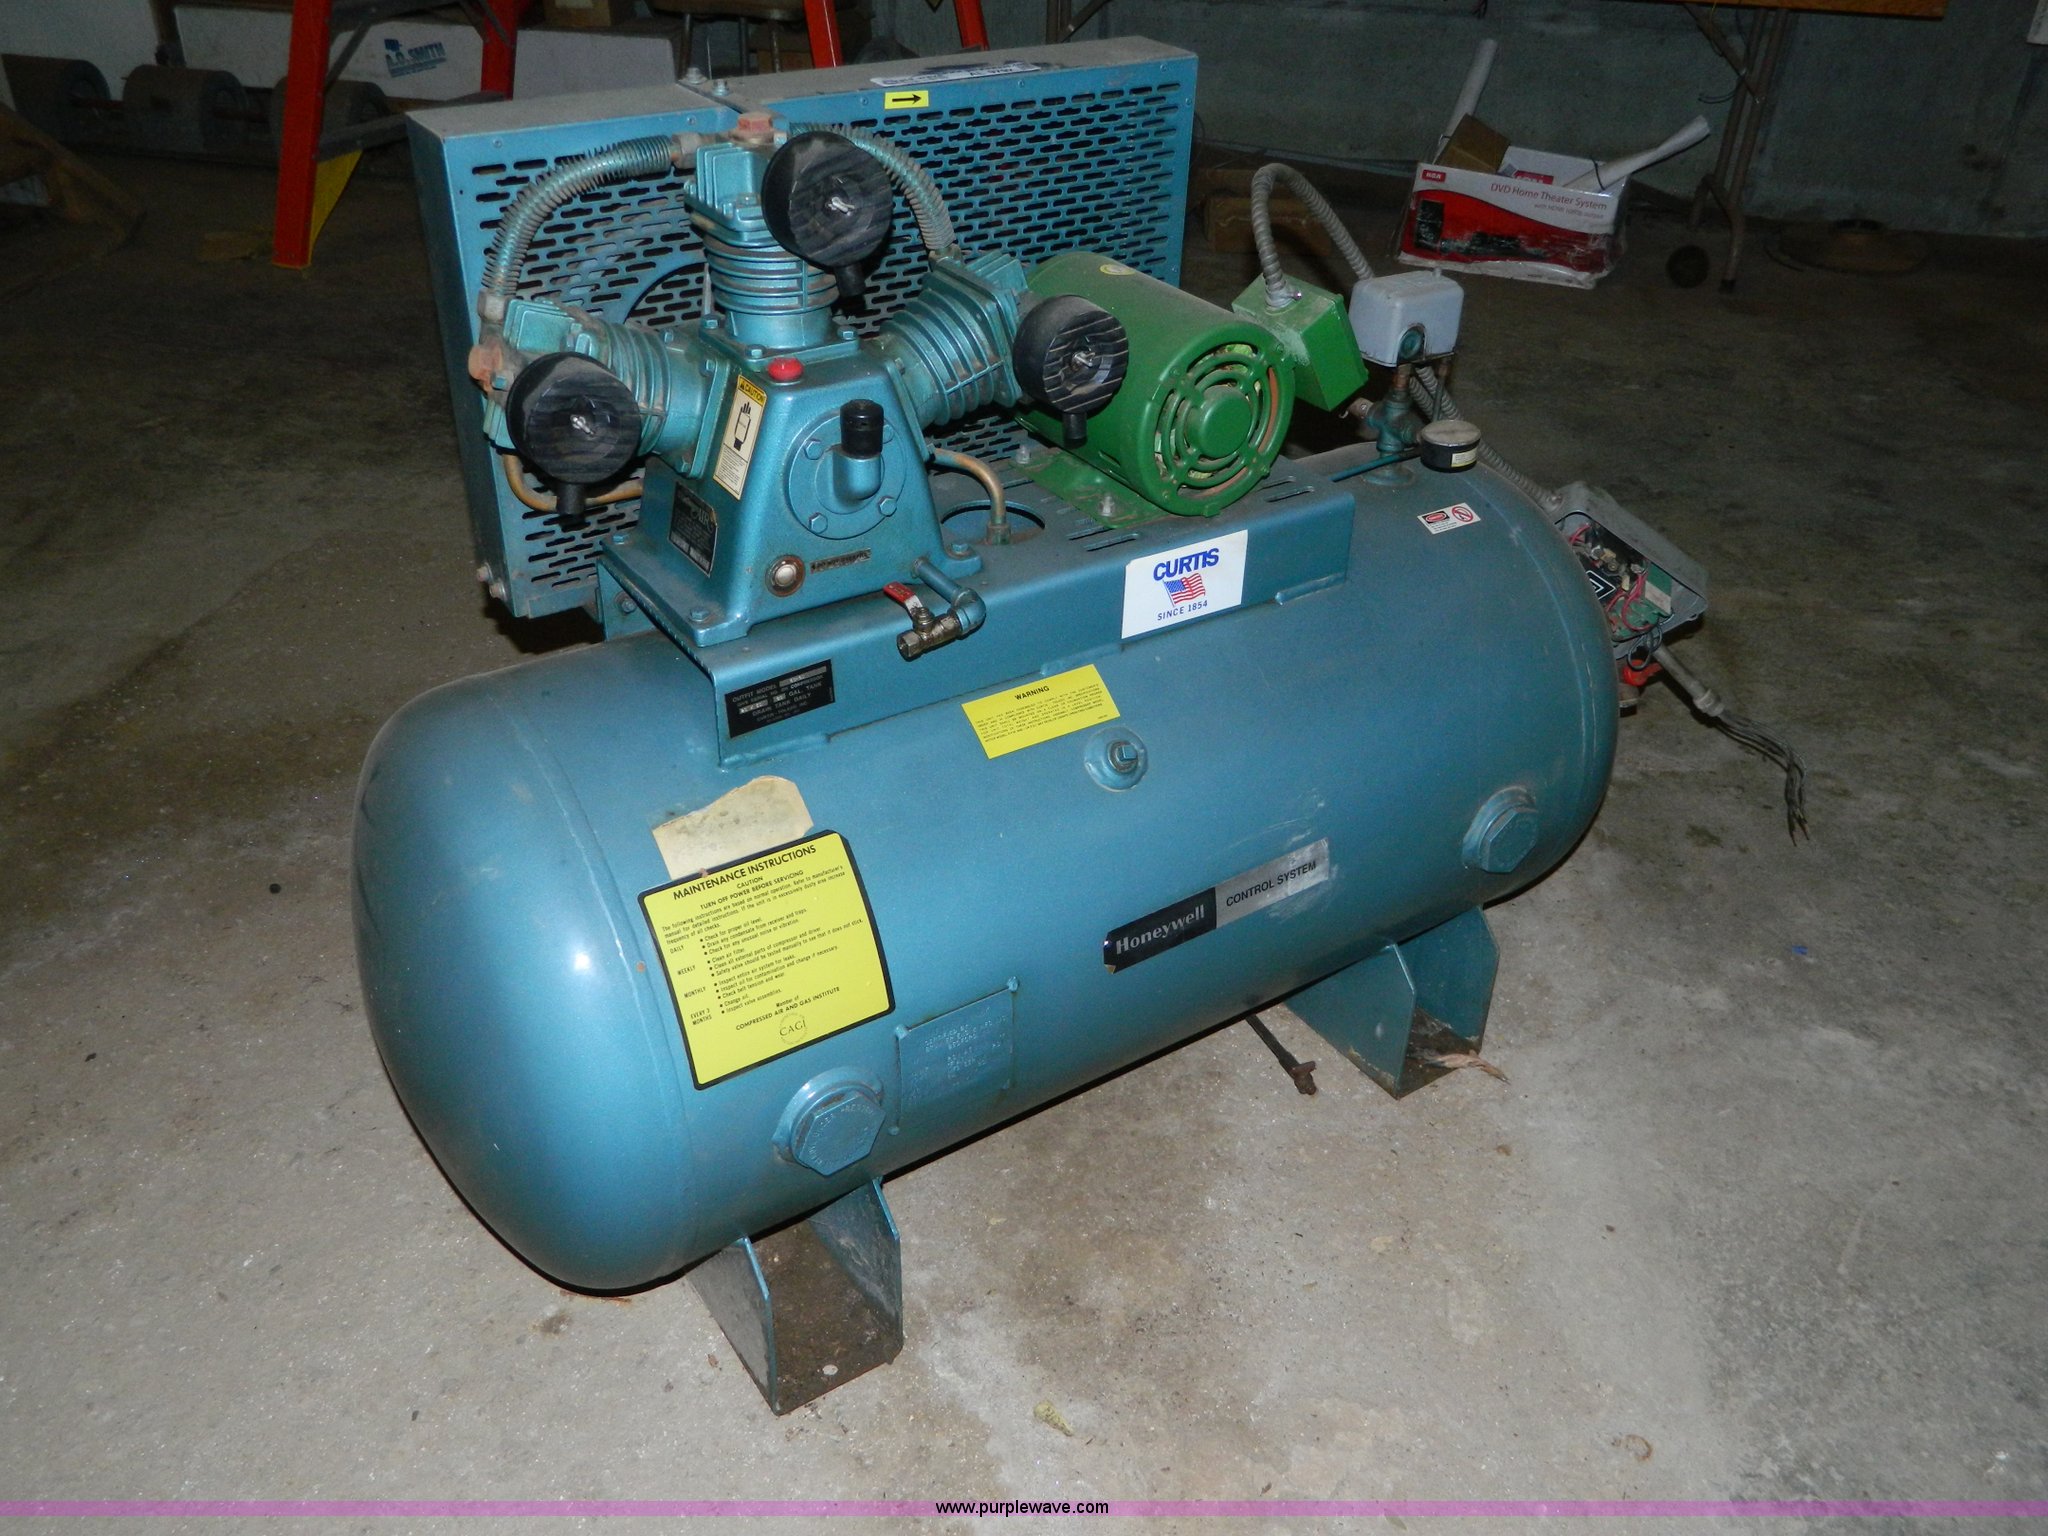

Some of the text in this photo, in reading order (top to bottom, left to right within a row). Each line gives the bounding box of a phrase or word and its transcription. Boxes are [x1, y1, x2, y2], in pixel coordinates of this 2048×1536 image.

[407, 41, 446, 60] SMITH
[1490, 183, 1607, 211] DVD Home Theater System
[1153, 548, 1219, 581] CURTIS
[1157, 600, 1208, 621] SINCE 1854
[1015, 685, 1049, 700] WARNING
[673, 844, 816, 900] MAINTENANCE INSTRUCTIONS
[700, 870, 803, 910] TURN OFF POWER BEFORE SERVICING
[737, 876, 763, 889] CAUTION
[1226, 860, 1317, 907] CONTROL SYSTEM
[664, 929, 681, 939] manual
[692, 919, 710, 929] detailed
[778, 886, 803, 899] excessively
[804, 881, 816, 890] dusty
[828, 871, 845, 880] increase
[672, 917, 693, 929] following
[695, 907, 722, 920] instructions
[732, 899, 745, 907] based
[753, 890, 769, 899] normal
[666, 933, 689, 946] frequency
[705, 932, 718, 941] Check
[727, 924, 742, 933] proper
[707, 939, 719, 947] Drain
[729, 927, 754, 939] condensate
[755, 922, 766, 930] from
[767, 916, 785, 925] receiver
[1116, 904, 1205, 955] Honeywell
[670, 944, 684, 954] DAILY
[708, 945, 722, 954] Check
[741, 932, 758, 942] unusual
[714, 961, 727, 969] Clean
[735, 951, 753, 961] external
[754, 947, 766, 955] parts
[773, 935, 798, 948] compressor
[712, 954, 725, 962] Clean
[716, 967, 730, 977] Safety
[732, 962, 743, 970] valve
[744, 956, 759, 965] should
[767, 948, 781, 957] tested
[782, 941, 801, 952] manually
[677, 965, 696, 975] WEEKLY
[719, 976, 736, 986] Inspect
[737, 970, 750, 979] entire
[759, 961, 774, 971] system
[721, 982, 738, 993] Inspect
[754, 964, 785, 979] contamination
[796, 955, 811, 965] change
[684, 986, 706, 998] MONTHLY
[722, 990, 735, 998] Check
[747, 979, 764, 989] tension
[724, 996, 741, 1007] Change
[726, 1003, 743, 1013] Inspect
[735, 986, 840, 1031] COMPRESSED AIR AND GAS INSTITUTE
[776, 998, 792, 1007] Member
[690, 1009, 705, 1019] EVERY
[692, 1014, 712, 1025] MONTHS
[779, 1019, 806, 1037] CAGI
